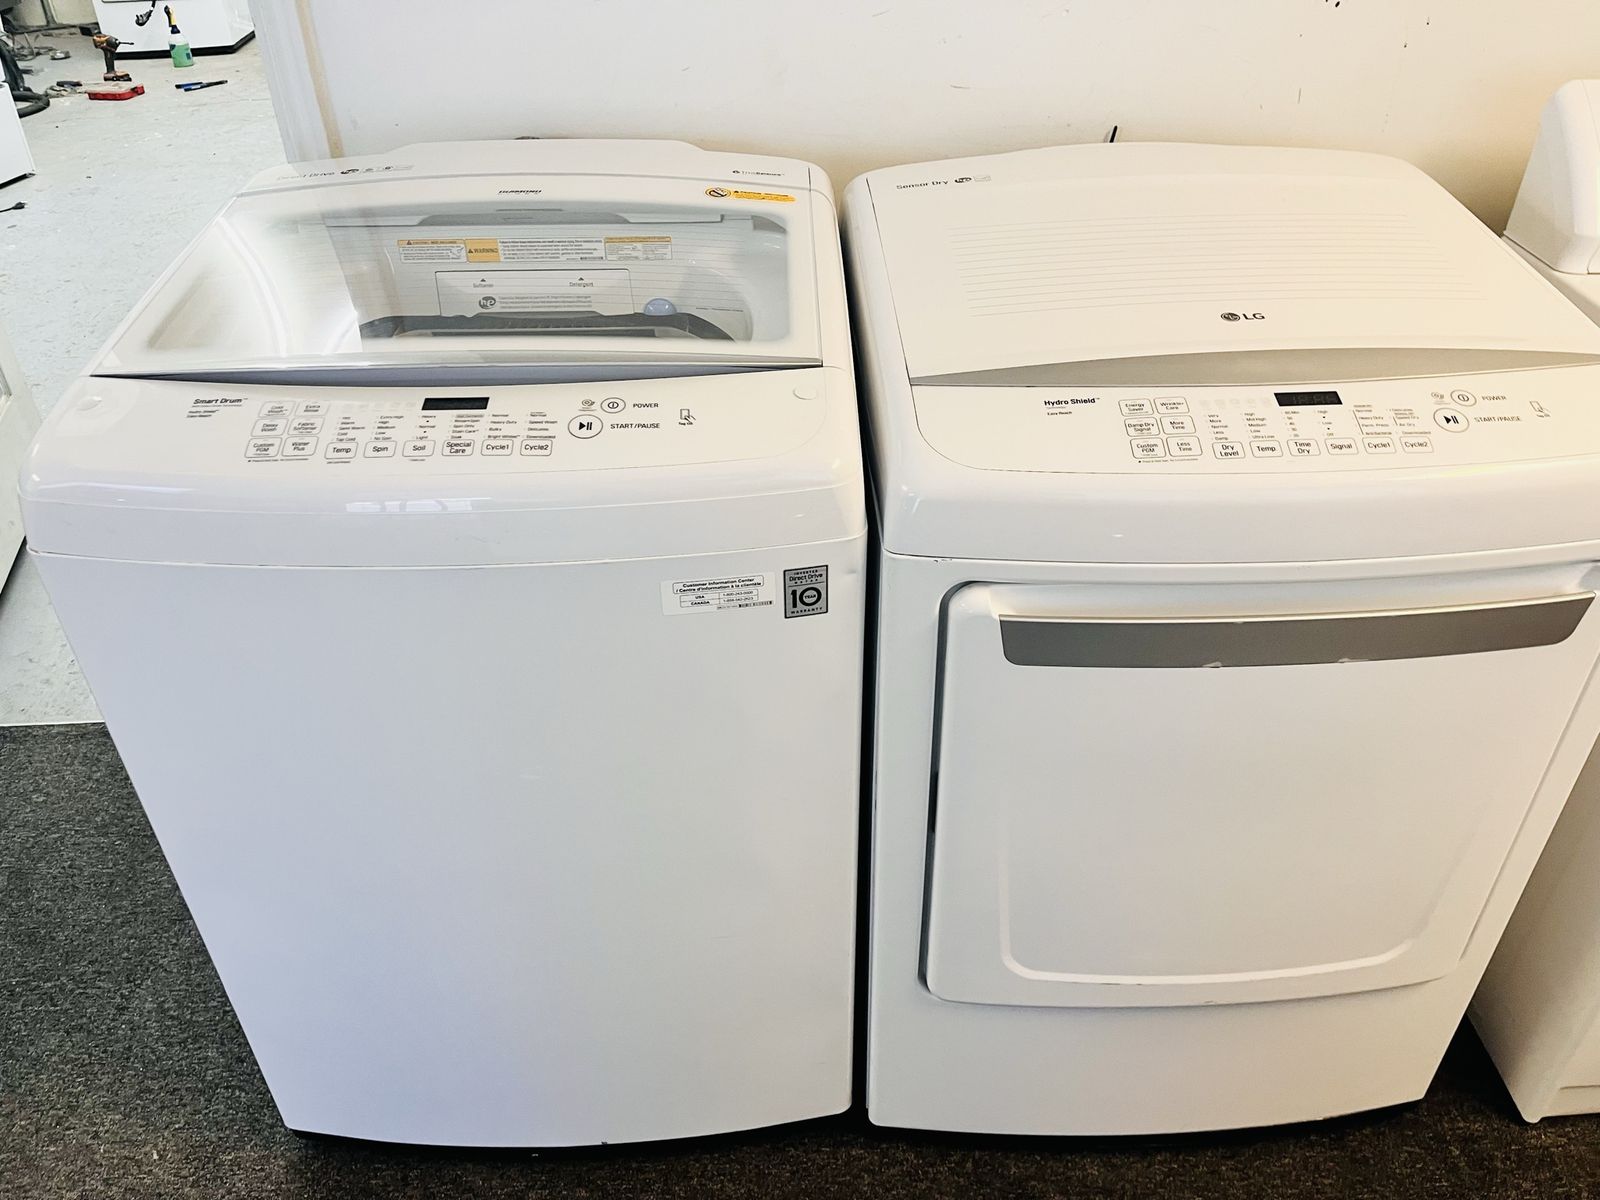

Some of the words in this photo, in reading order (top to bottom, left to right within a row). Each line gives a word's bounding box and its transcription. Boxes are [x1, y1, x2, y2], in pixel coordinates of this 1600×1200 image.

[896, 182, 928, 190] Sensor
[220, 397, 242, 405] Drum
[332, 446, 351, 454] Temp
[372, 445, 389, 453] Spin
[485, 444, 509, 452] Cycle1
[524, 444, 549, 452] Cycle2
[790, 586, 823, 609] 10
[790, 606, 823, 615] WARRANTY
